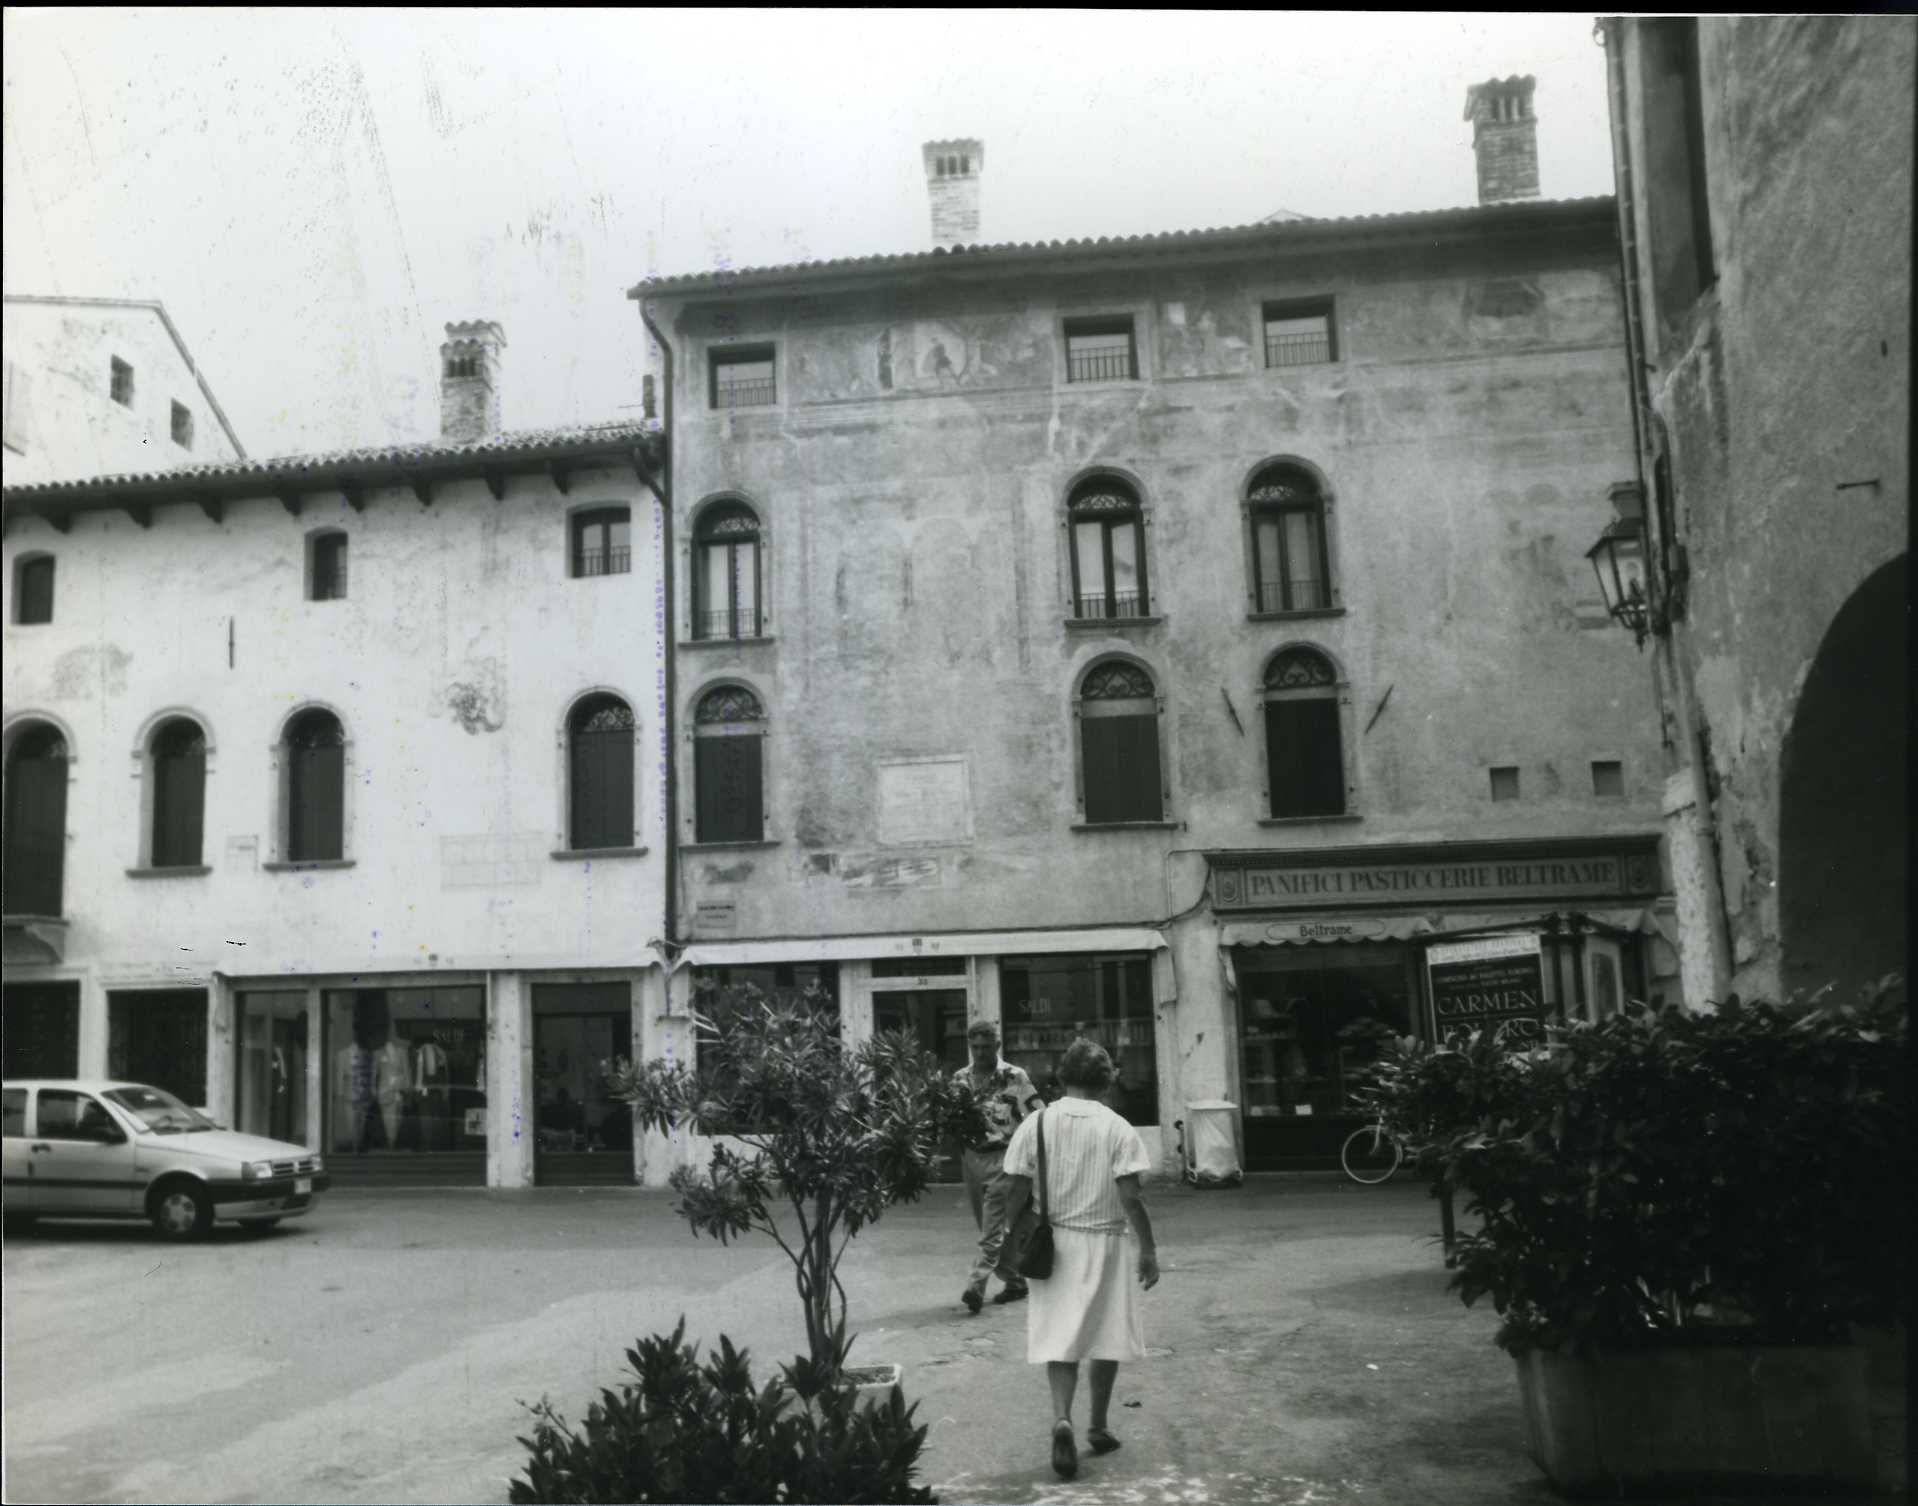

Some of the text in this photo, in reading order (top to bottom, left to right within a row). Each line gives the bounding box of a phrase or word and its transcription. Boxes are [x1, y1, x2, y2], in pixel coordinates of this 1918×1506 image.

[1252, 861, 1615, 896] PANIFICI PASTICCERIE BELTRAME
[1300, 923, 1352, 937] Beltrame
[1438, 990, 1537, 1015] CARMEN
